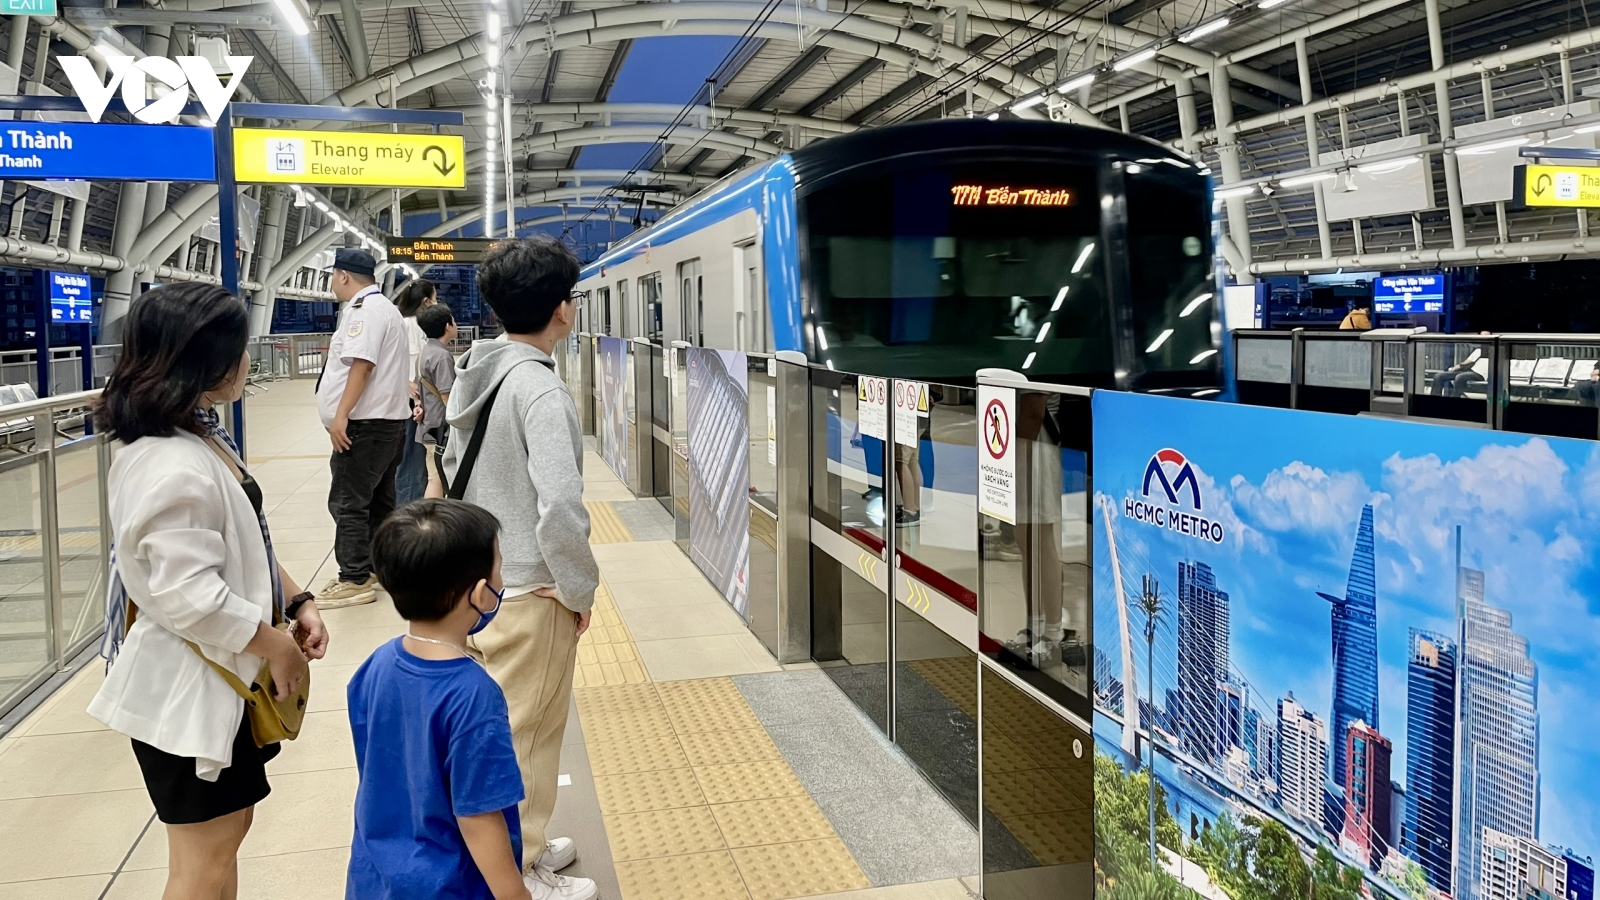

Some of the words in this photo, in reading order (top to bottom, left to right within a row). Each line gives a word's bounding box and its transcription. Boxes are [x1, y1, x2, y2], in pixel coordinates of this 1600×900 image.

[9, 0, 43, 10] EXIT
[7, 130, 73, 150] Thành
[311, 140, 369, 161] Thang
[376, 143, 414, 163] máy
[311, 163, 365, 176] Elevator
[985, 186, 1018, 205] Bến
[1018, 188, 1070, 205] Thành
[391, 247, 412, 255] 18:15
[1125, 499, 1164, 526] HCMC
[1169, 510, 1223, 543] METRO
